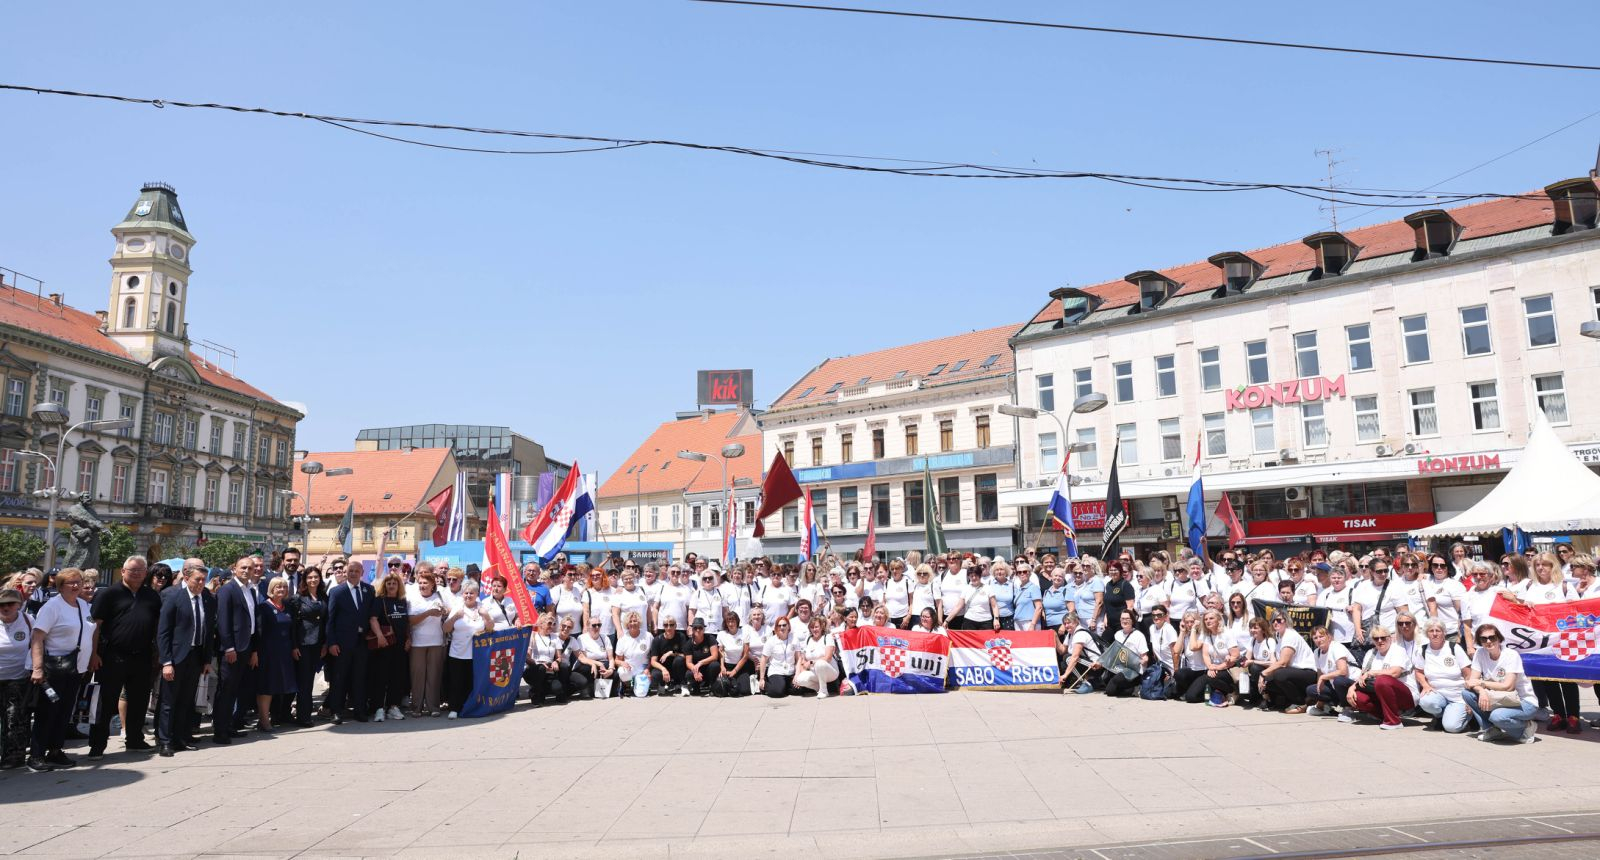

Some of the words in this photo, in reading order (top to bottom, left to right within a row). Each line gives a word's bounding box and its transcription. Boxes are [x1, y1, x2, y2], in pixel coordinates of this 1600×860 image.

[712, 376, 737, 400] kik
[1225, 374, 1346, 411] KONZUM
[1417, 453, 1500, 474] KONZUM
[1343, 518, 1377, 529] TISAK
[515, 583, 530, 624] BRIGADA
[955, 666, 995, 687] SABO
[1011, 665, 1054, 683] RSKO
